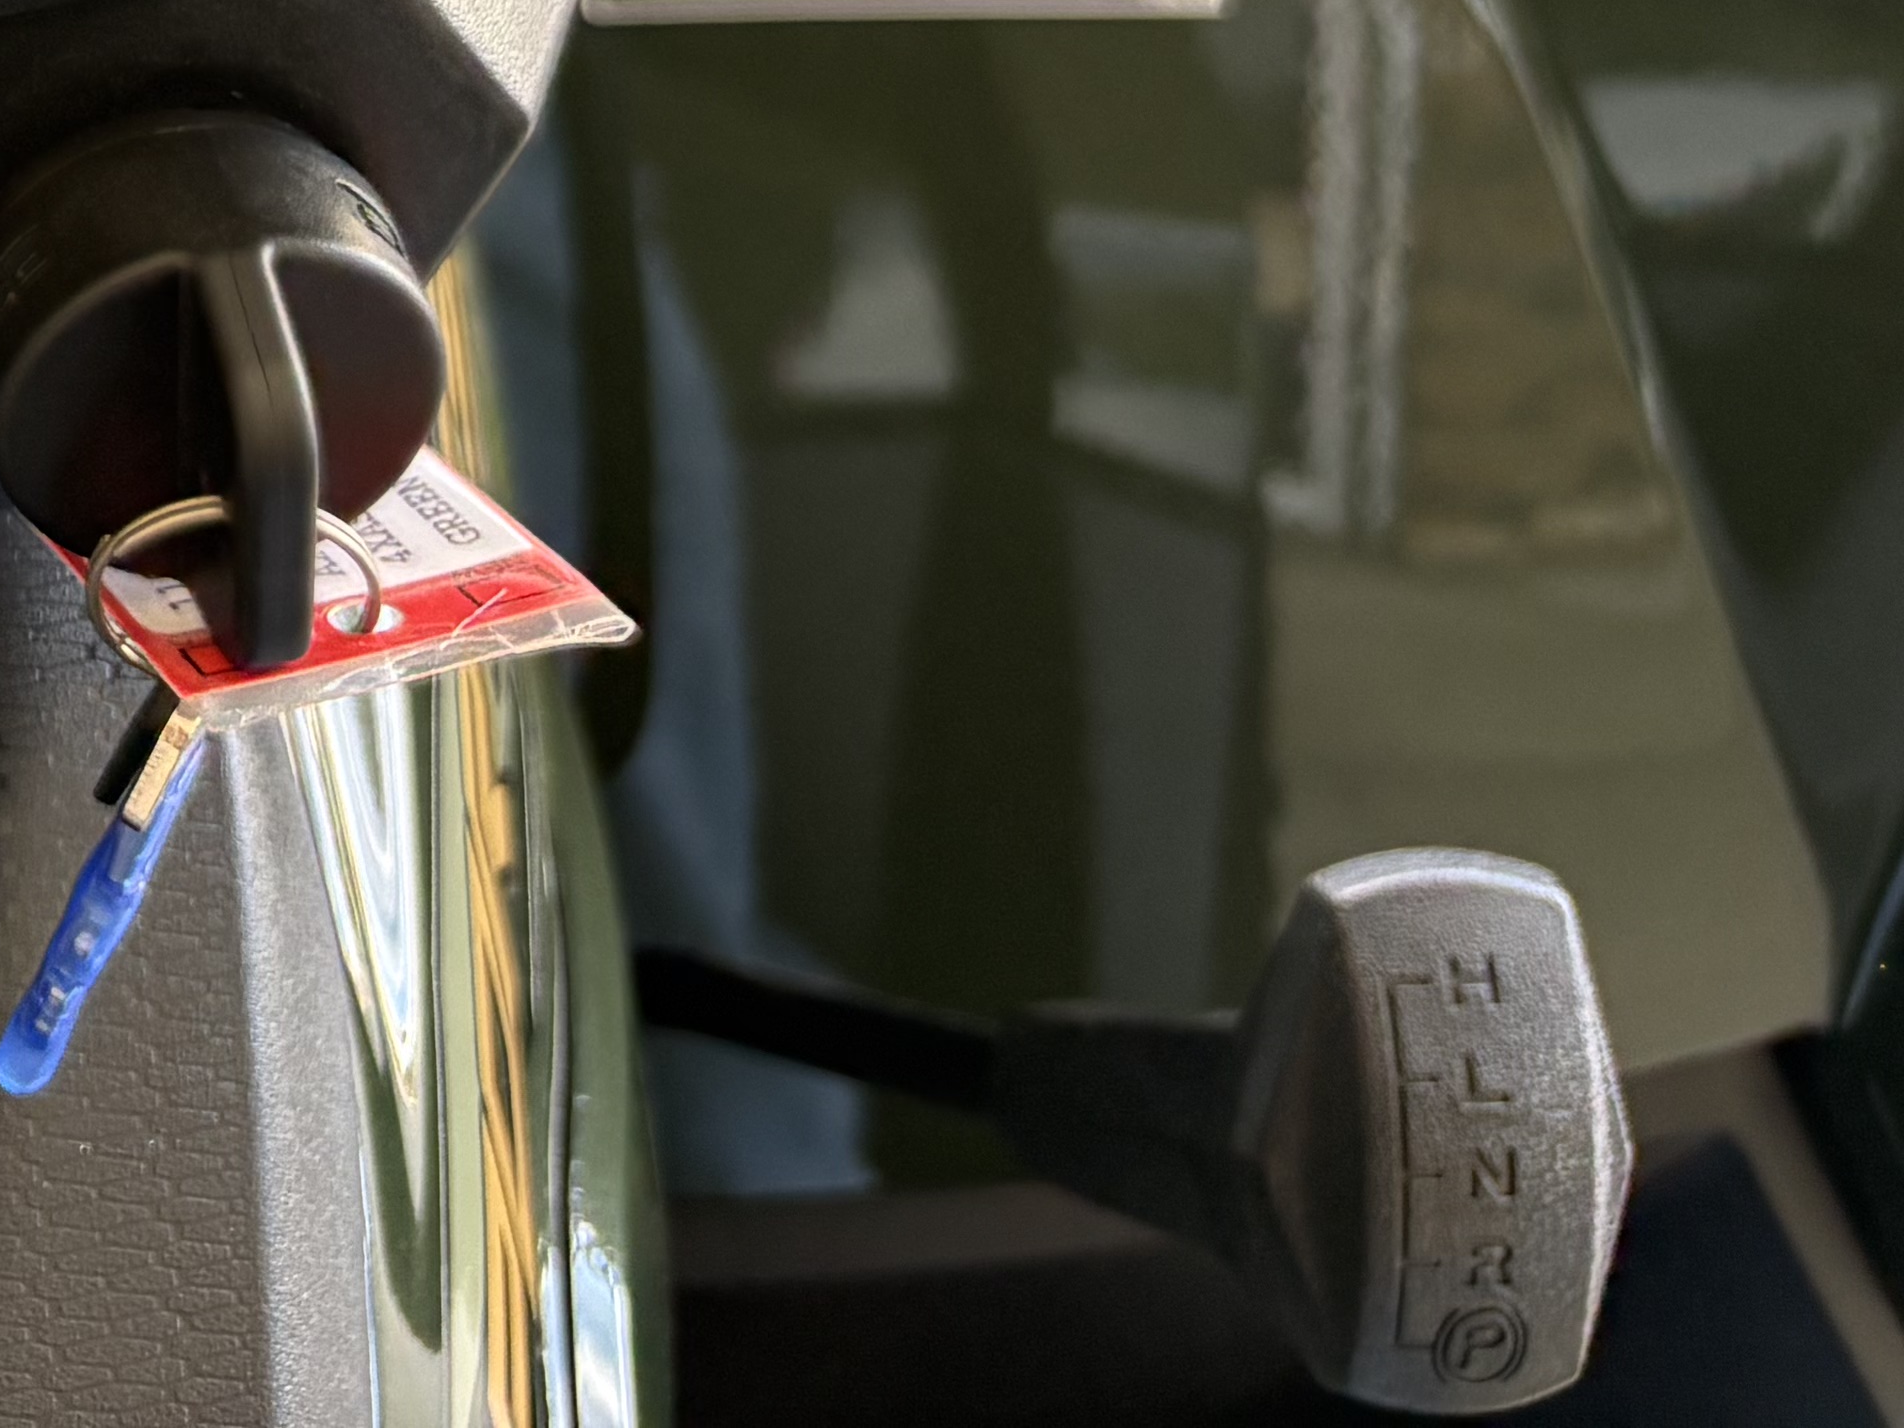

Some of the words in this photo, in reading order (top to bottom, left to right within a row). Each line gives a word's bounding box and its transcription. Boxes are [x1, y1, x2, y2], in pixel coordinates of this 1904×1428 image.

[396, 475, 480, 546] GREEN
[1449, 952, 1501, 1005] H
[1462, 1054, 1511, 1107] L
[1470, 1148, 1516, 1199] N
[1467, 1243, 1514, 1286] R
[1459, 1322, 1507, 1372] P
